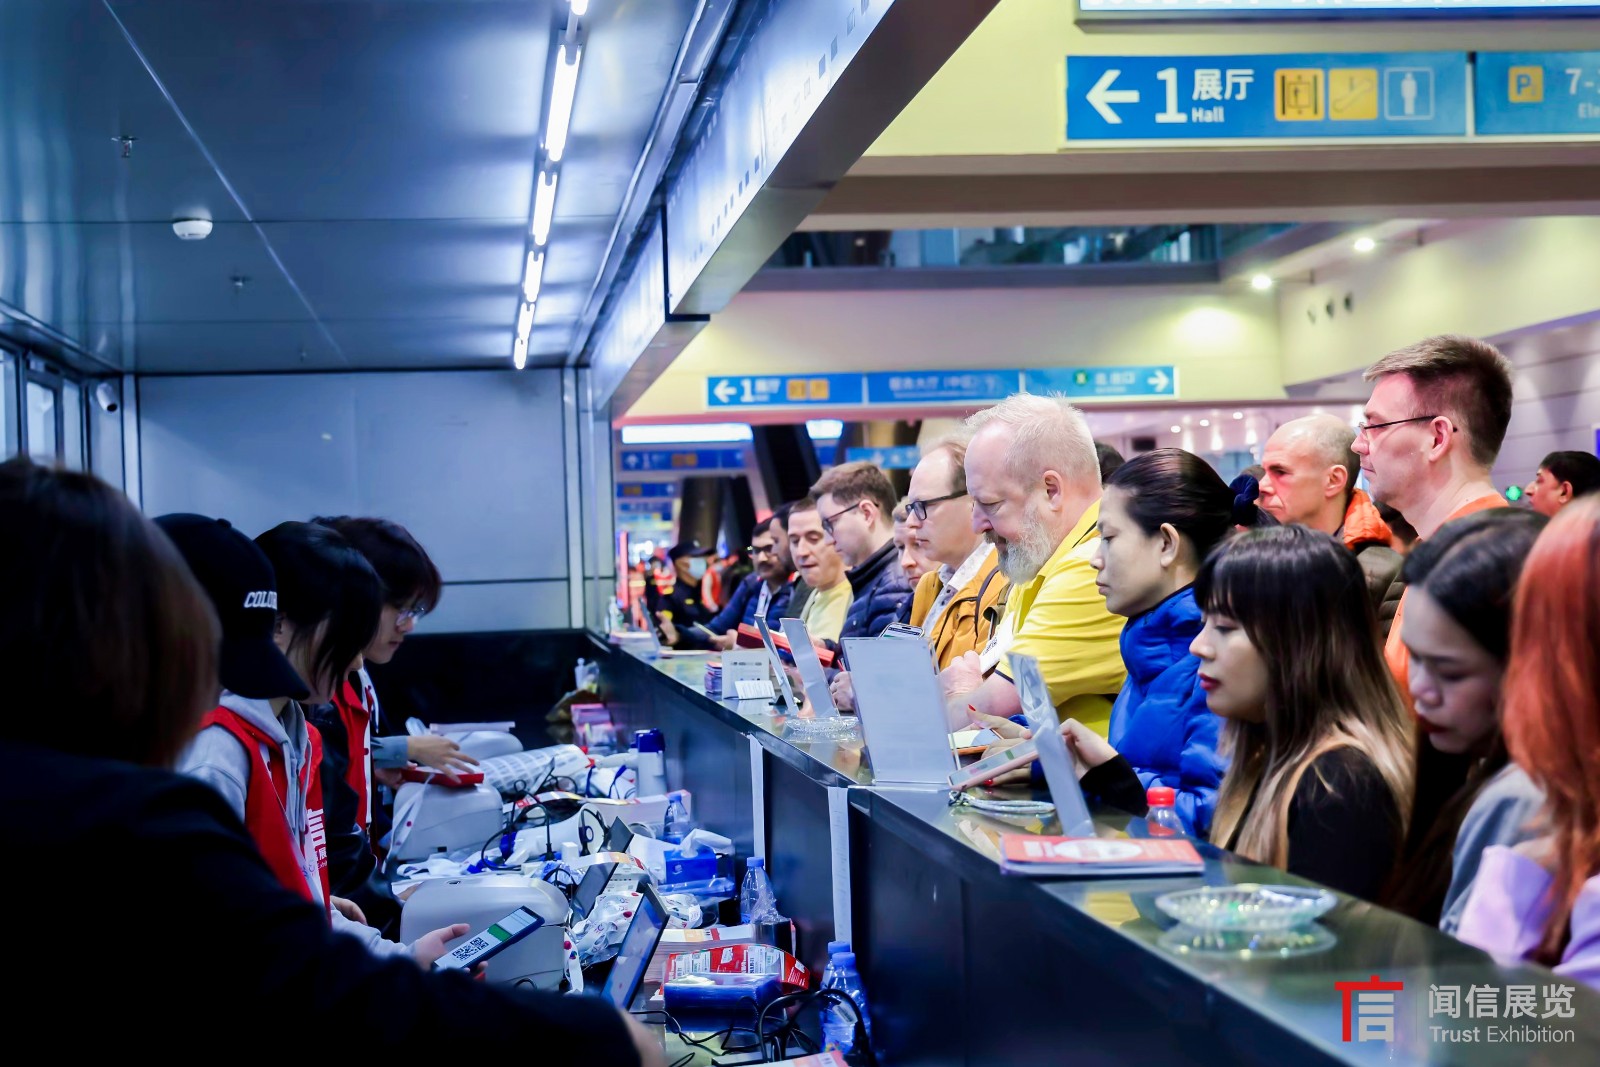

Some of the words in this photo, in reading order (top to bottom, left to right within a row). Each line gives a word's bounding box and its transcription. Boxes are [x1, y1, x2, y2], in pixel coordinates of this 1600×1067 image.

[1155, 67, 1188, 124] 1
[1192, 68, 1255, 101] 展厅
[1191, 106, 1225, 123] Hall
